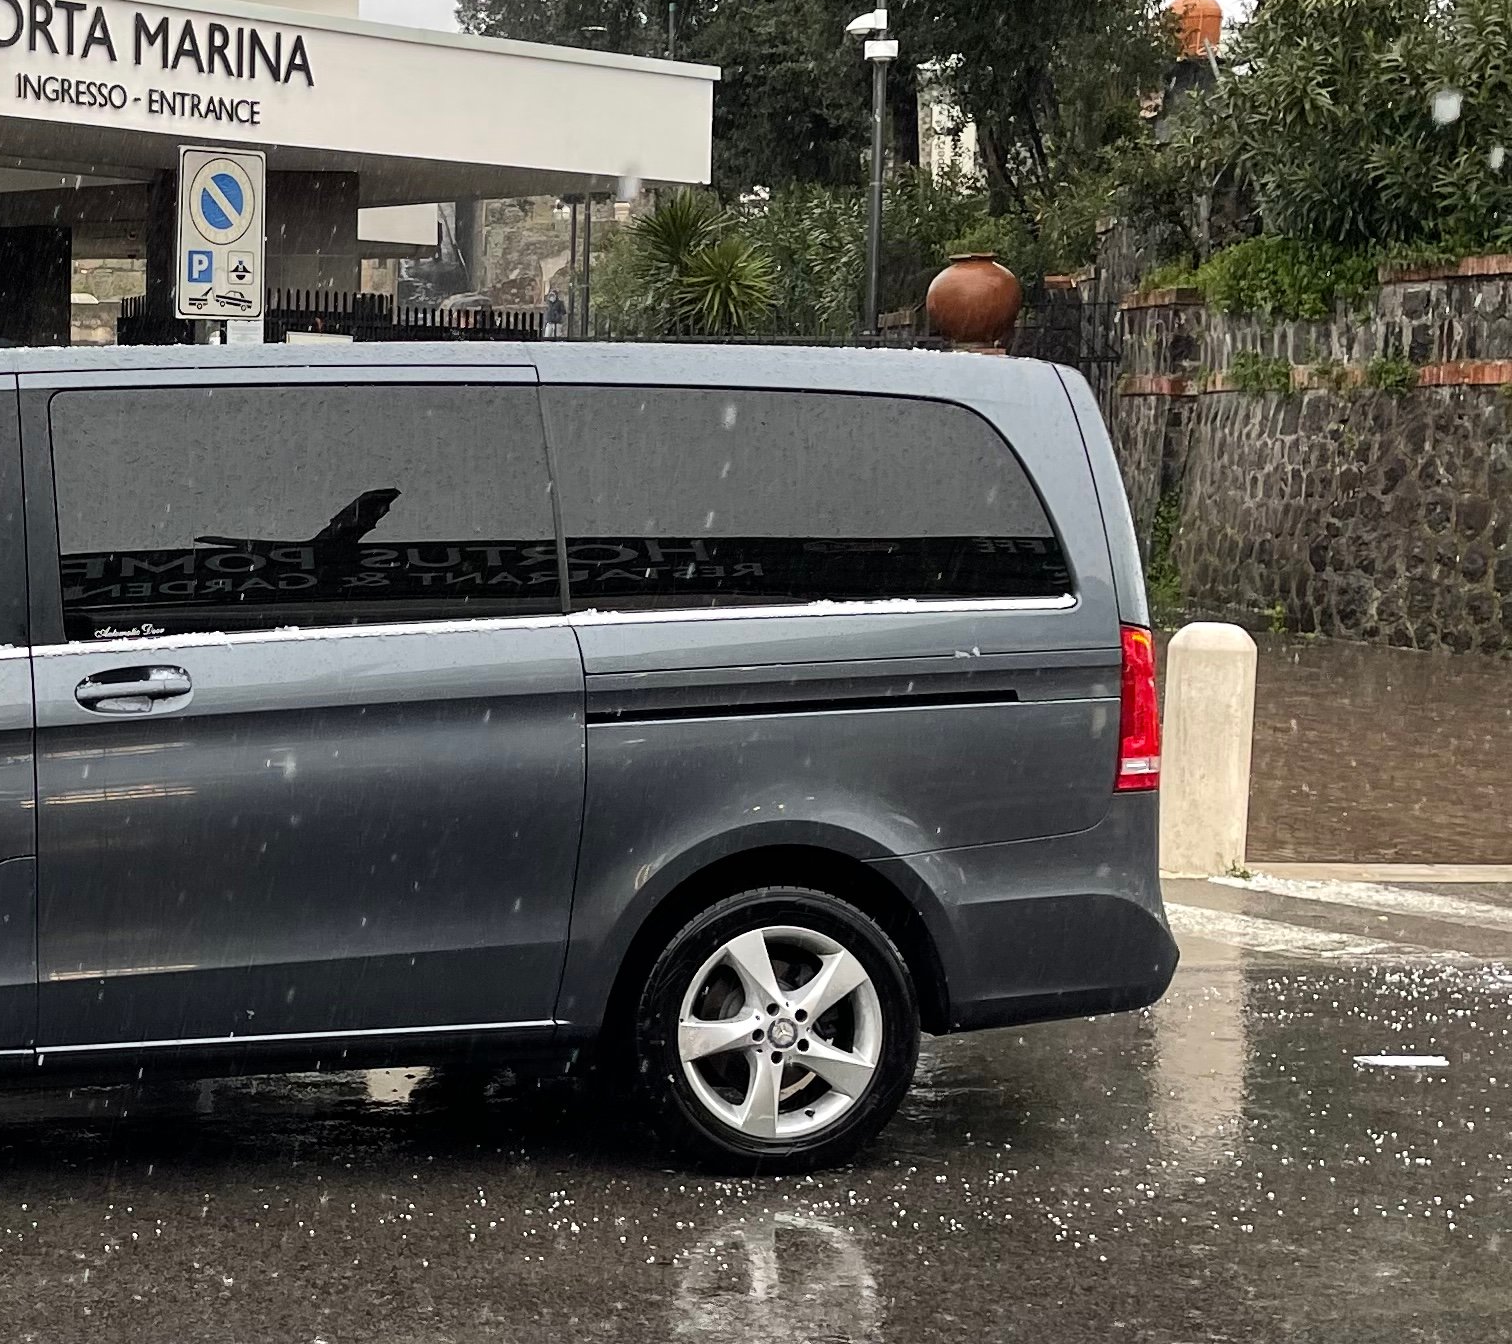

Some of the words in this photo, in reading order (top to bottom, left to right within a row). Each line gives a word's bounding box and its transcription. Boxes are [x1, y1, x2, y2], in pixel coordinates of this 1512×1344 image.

[134, 11, 315, 87] MARINA
[16, 71, 128, 109] INGRESSO
[147, 88, 261, 125] ENTRANCE
[192, 254, 209, 280] P
